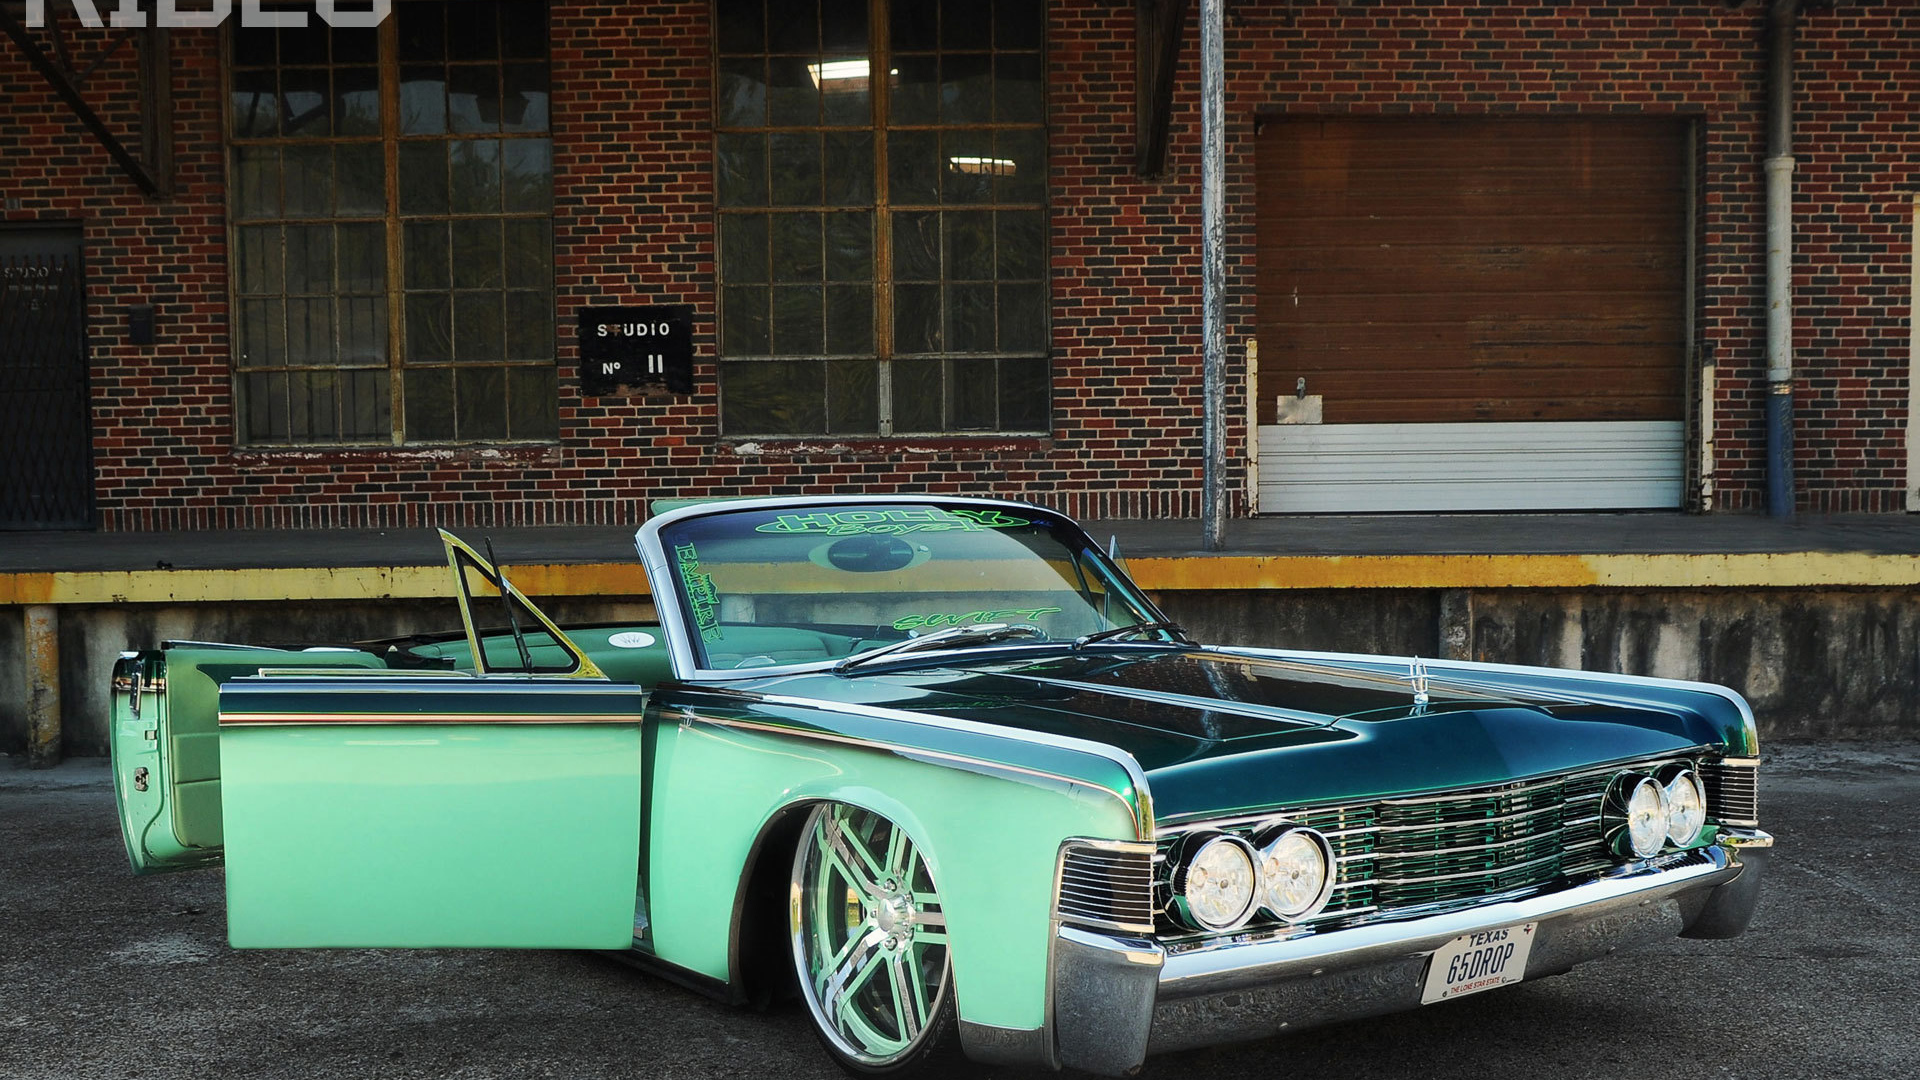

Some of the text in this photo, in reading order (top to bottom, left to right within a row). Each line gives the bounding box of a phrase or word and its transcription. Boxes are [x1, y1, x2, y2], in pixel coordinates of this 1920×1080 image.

[597, 322, 670, 337] STUDIO
[777, 510, 1001, 531] HOLLY
[675, 542, 724, 644] EMPIRE
[893, 607, 1062, 630] SWIFT
[1469, 928, 1509, 947] TEXAS
[1446, 942, 1514, 984] 65DROP
[1460, 982, 1473, 991] LONE
[1473, 980, 1486, 988] STAR
[1486, 976, 1500, 985] STATE
